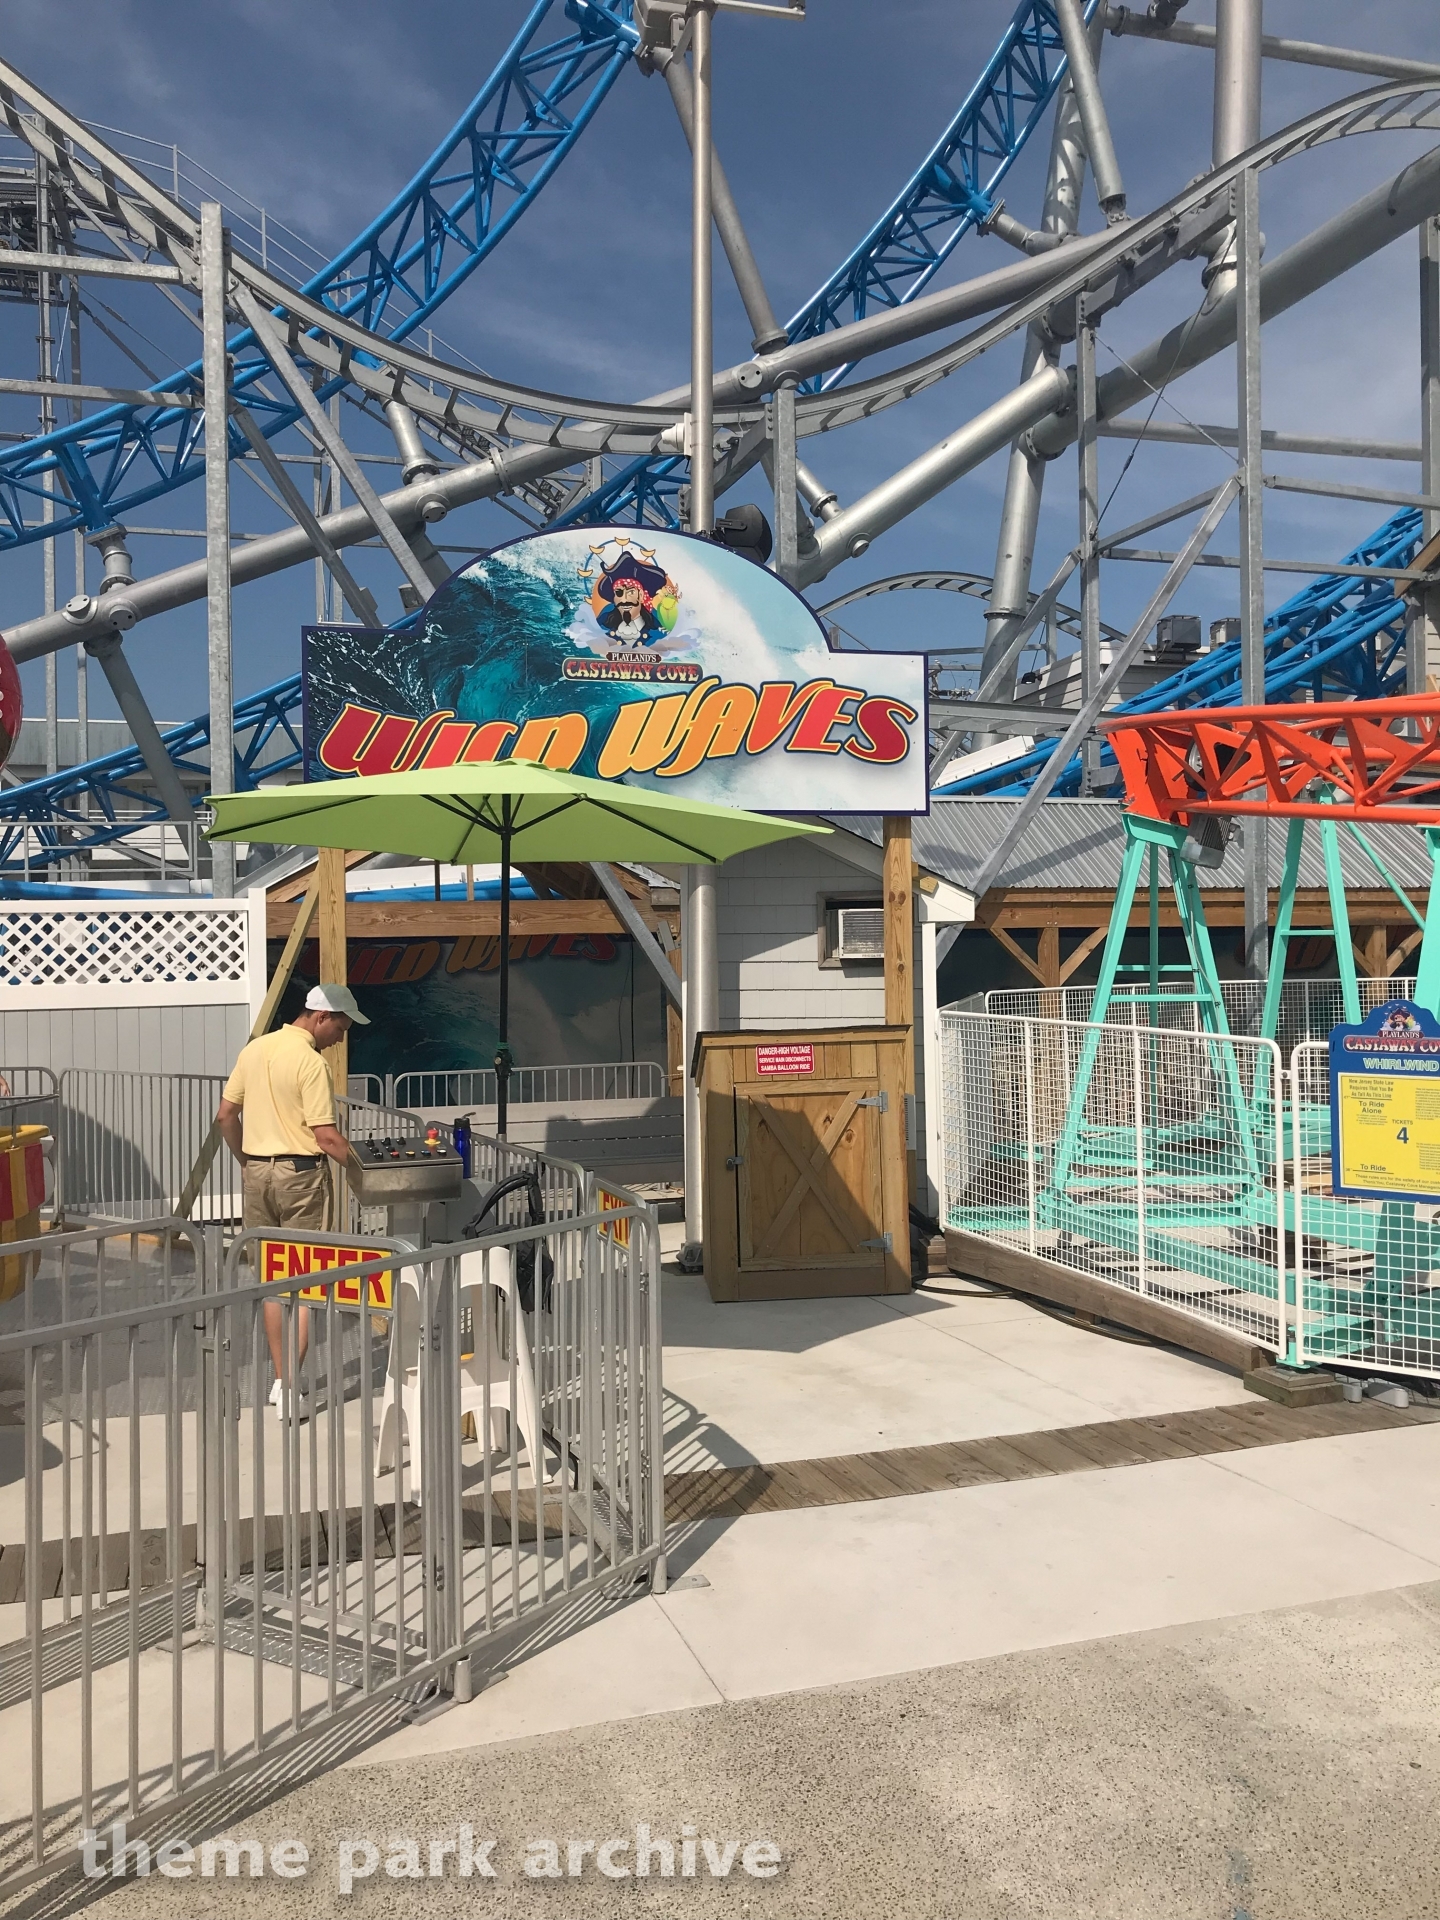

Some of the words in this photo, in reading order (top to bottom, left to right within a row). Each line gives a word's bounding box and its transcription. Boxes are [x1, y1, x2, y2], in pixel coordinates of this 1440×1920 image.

[611, 653, 657, 662] PLAYLAND'S
[566, 661, 653, 680] CASTAWAY
[656, 665, 699, 682] COVE
[319, 702, 589, 777] WILD
[597, 677, 918, 778] WAVES
[758, 1047, 789, 1056] DANGER-HIGH
[790, 1046, 811, 1054] VOLTAGE
[1346, 1037, 1417, 1053] CASTAWAY
[1420, 1040, 1440, 1053] CO
[1363, 1057, 1440, 1072] WHIRLWIND
[1396, 1126, 1410, 1145] 4
[266, 1242, 386, 1303] ENTER
